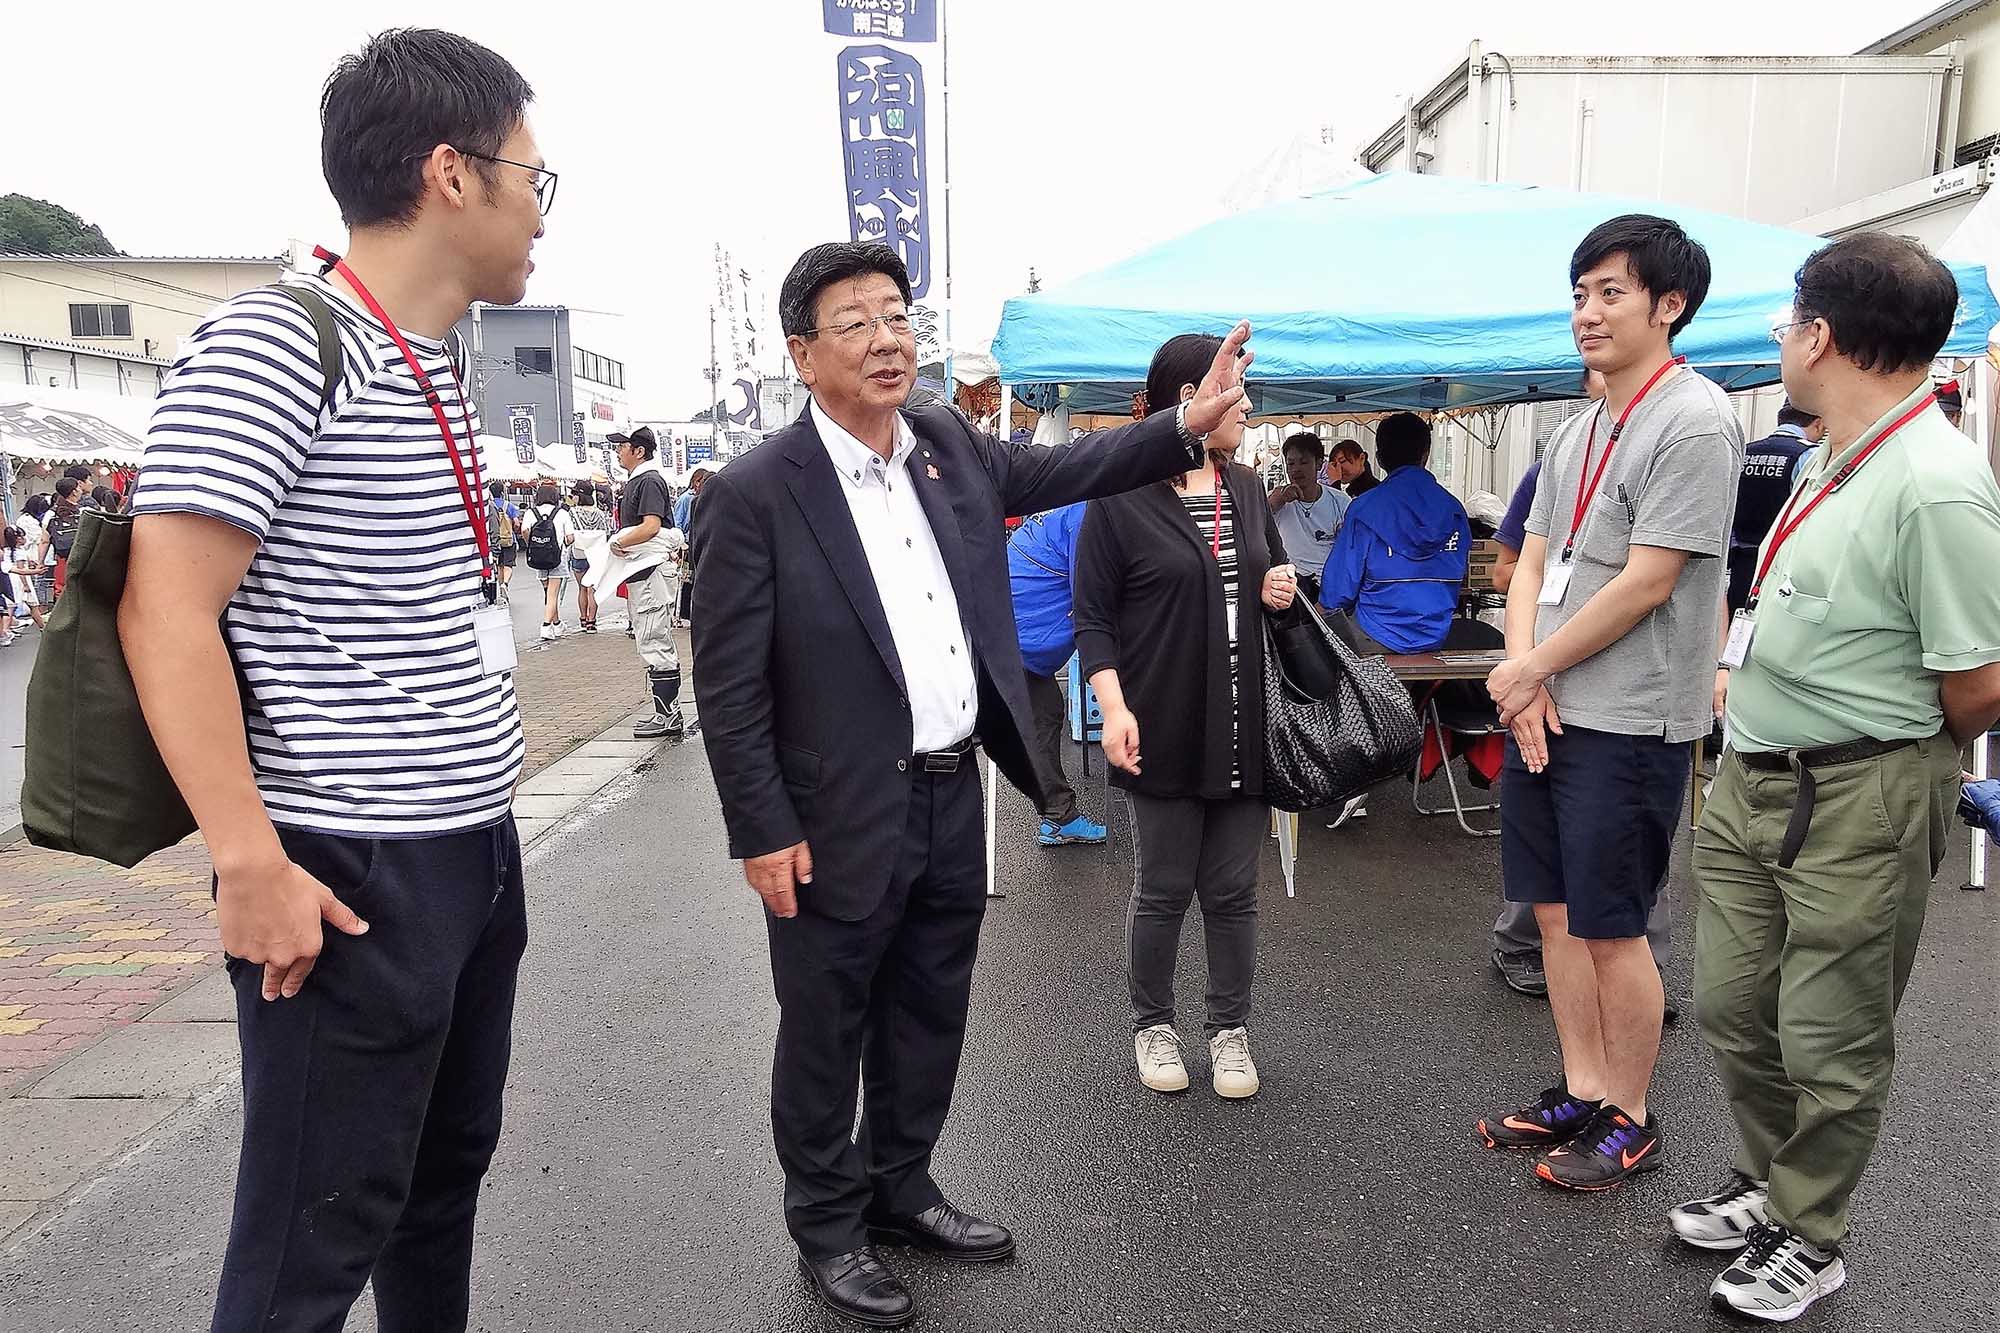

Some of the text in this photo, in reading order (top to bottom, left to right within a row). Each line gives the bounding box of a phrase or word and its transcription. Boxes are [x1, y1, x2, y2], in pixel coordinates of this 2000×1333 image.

[853, 12, 904, 38] 南三陸
[1739, 465, 1784, 477] POLICE
